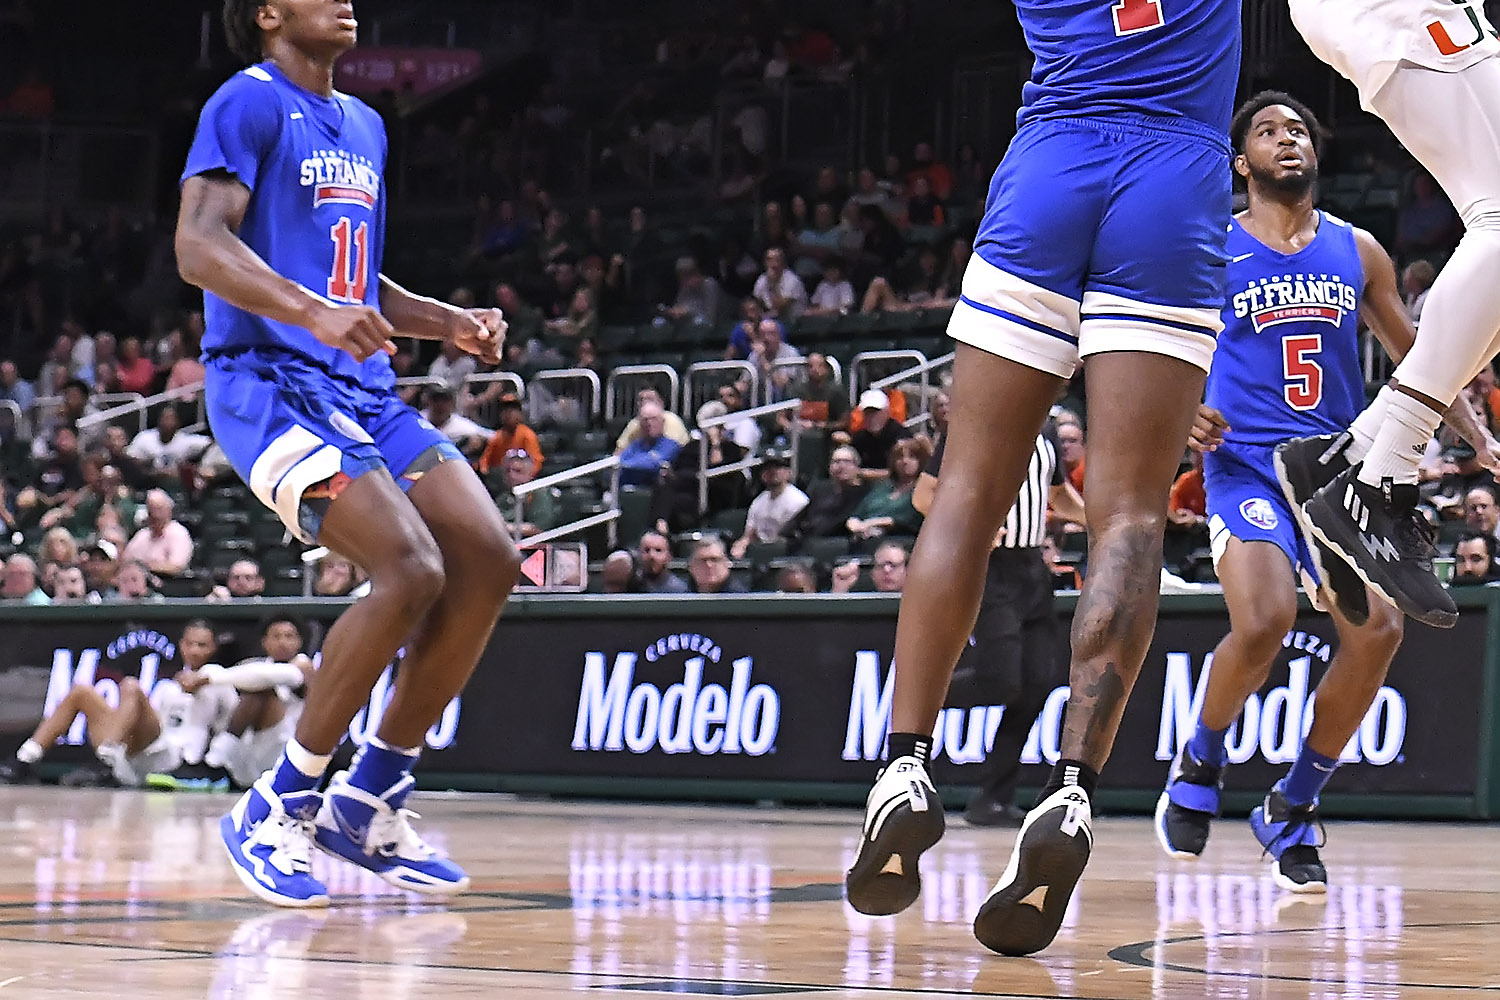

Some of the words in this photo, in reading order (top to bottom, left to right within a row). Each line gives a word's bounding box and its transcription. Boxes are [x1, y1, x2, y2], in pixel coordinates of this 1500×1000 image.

[327, 216, 368, 305] 11
[1282, 334, 1323, 411] 5
[646, 632, 721, 663] CERVEZA
[571, 650, 776, 755] Modelo
